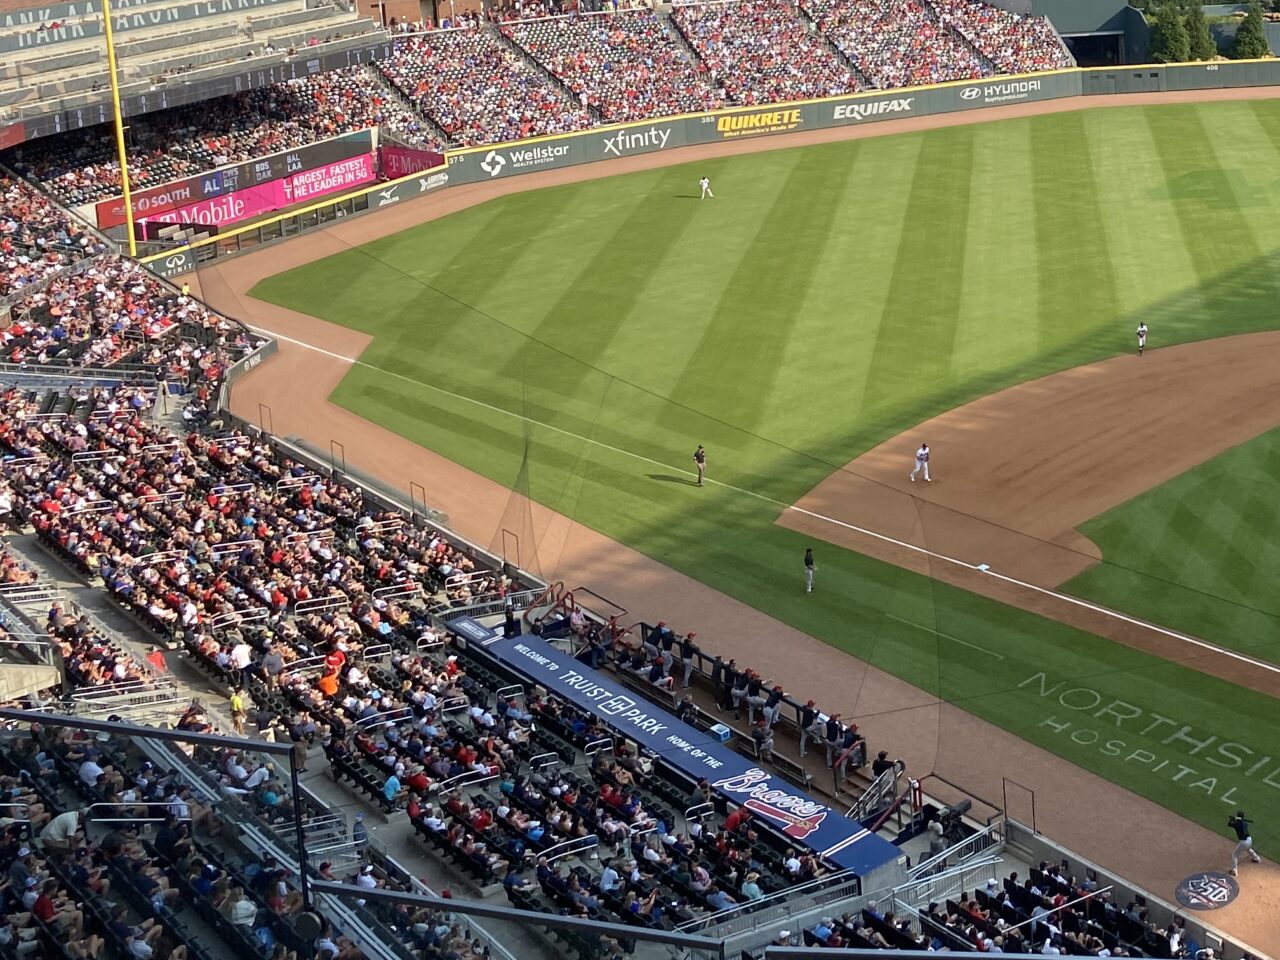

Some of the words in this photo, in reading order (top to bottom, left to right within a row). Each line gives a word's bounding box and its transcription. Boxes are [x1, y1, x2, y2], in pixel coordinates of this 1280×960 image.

[985, 80, 1041, 96] HYUNDAI
[833, 98, 912, 120] EQUIFAX
[717, 109, 801, 132] QUIKRETE
[603, 126, 672, 156] xfinity
[286, 153, 300, 163] BAL
[449, 155, 464, 165] 375
[509, 145, 569, 163] Wellstar
[513, 159, 534, 168] HEALTH
[534, 157, 554, 165] SYSTEM
[283, 170, 329, 188] LARGEST.
[330, 158, 367, 176] FASTEST.
[287, 162, 302, 172] LAA
[204, 180, 220, 193] AL
[223, 176, 238, 188] DET
[284, 184, 308, 199] THE
[308, 175, 345, 194] LEADER
[345, 172, 355, 184] IN
[355, 168, 368, 179] 5G
[152, 187, 190, 208] SOUTH
[513, 643, 550, 665] WELCOME
[545, 662, 560, 671] TO
[558, 670, 613, 701] TRUIST
[621, 708, 668, 736] PARK
[666, 734, 692, 752] HOME
[690, 749, 706, 759] OF
[702, 754, 724, 770] THE
[1038, 716, 1240, 806] HOSPITAL
[711, 768, 826, 817] Braves
